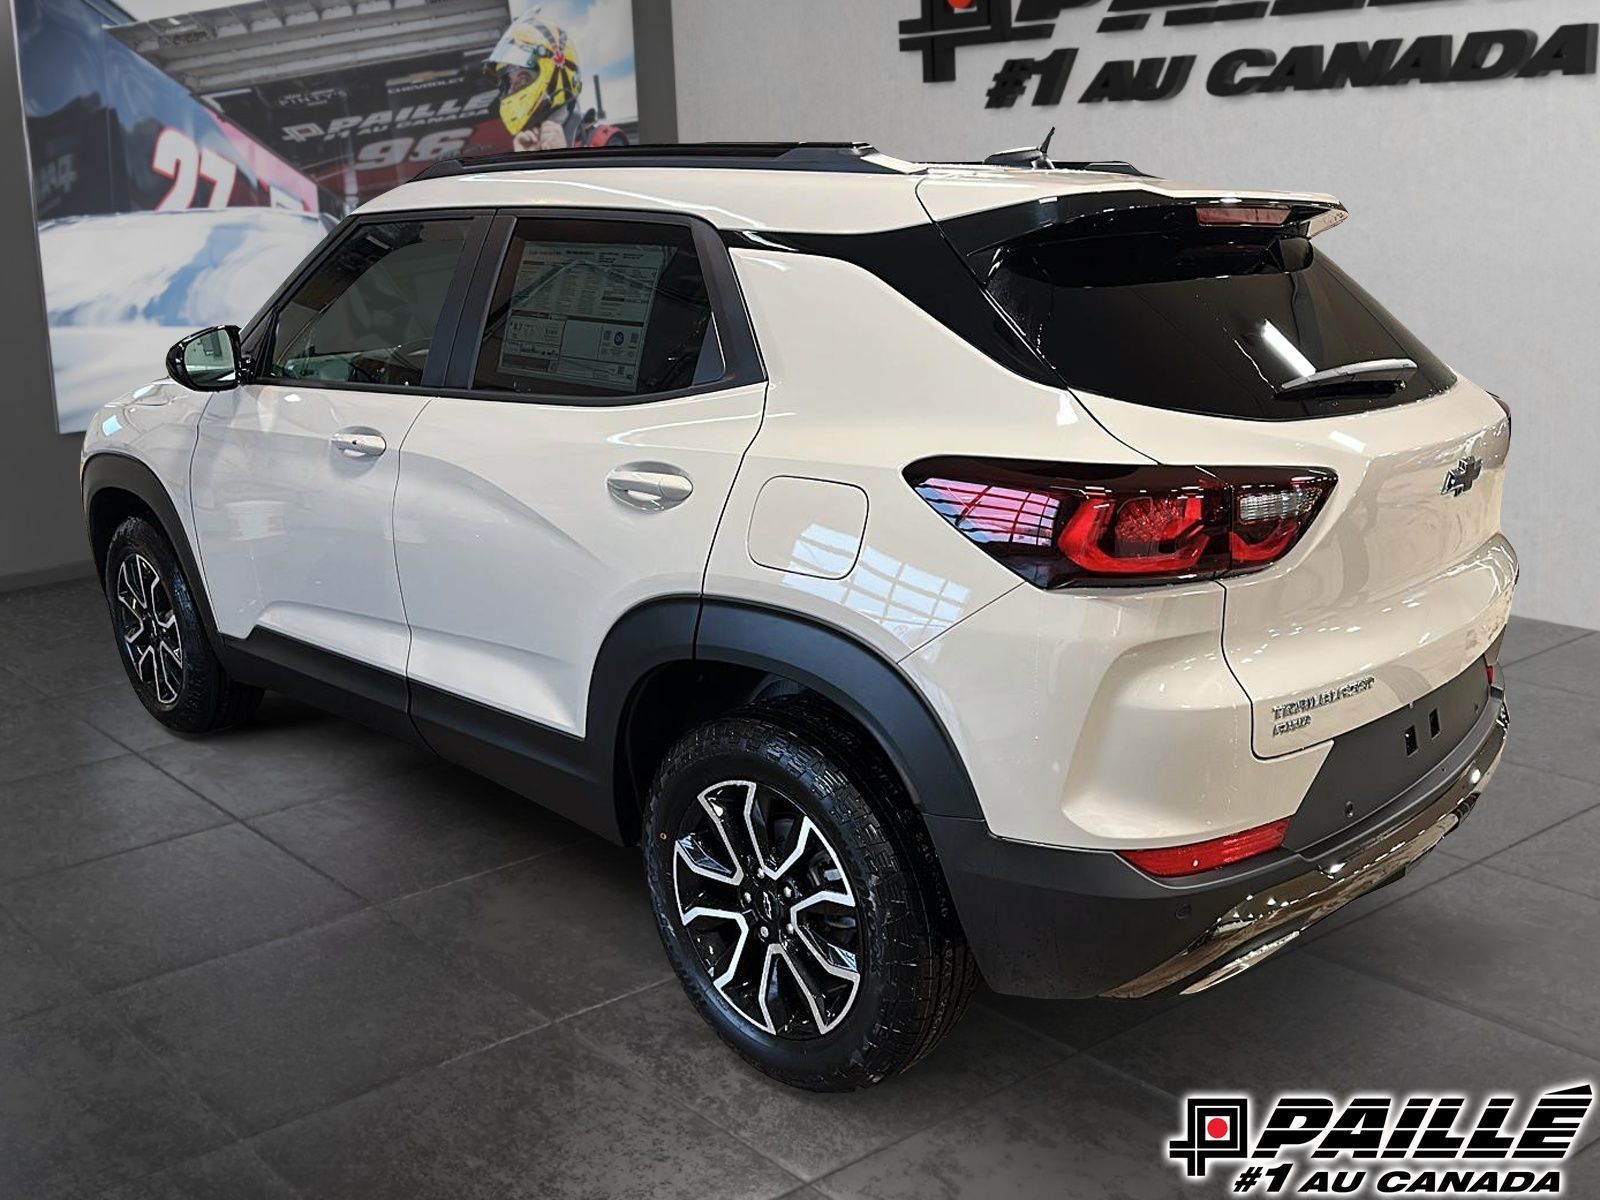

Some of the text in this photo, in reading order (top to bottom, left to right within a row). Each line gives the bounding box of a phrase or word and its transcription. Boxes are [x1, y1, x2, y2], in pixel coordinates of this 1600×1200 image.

[985, 22, 1599, 110] #1 AU CANADA
[387, 77, 464, 95] CHEVROLET
[356, 125, 389, 137] AU
[396, 108, 490, 129] CANADA
[354, 127, 474, 171] 96
